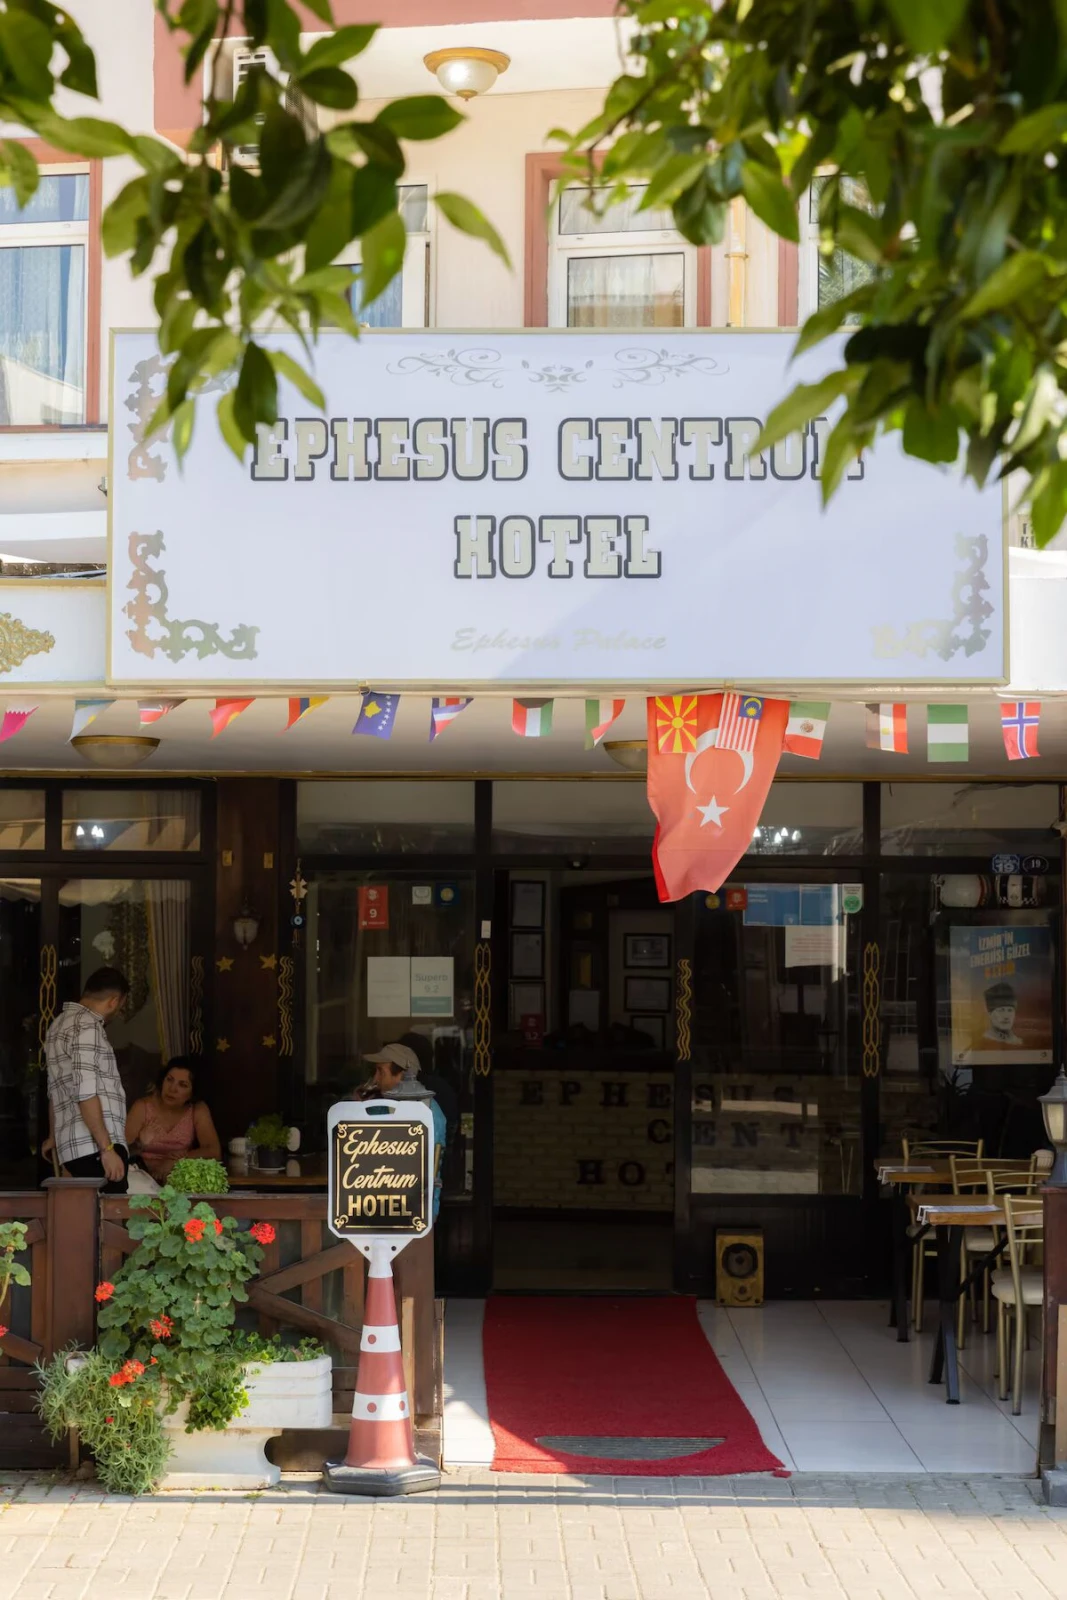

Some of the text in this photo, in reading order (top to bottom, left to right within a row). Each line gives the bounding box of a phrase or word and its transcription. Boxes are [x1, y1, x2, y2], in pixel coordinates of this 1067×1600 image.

[250, 417, 528, 481] EPHESUS
[454, 515, 661, 579] HOTEL
[451, 627, 669, 653] Ephesus Palace
[1031, 858, 1041, 869] 19
[369, 908, 378, 919] 9
[343, 1129, 419, 1163] Ephesus
[342, 1163, 418, 1189] Centrum
[348, 1195, 412, 1217] HOTEL
